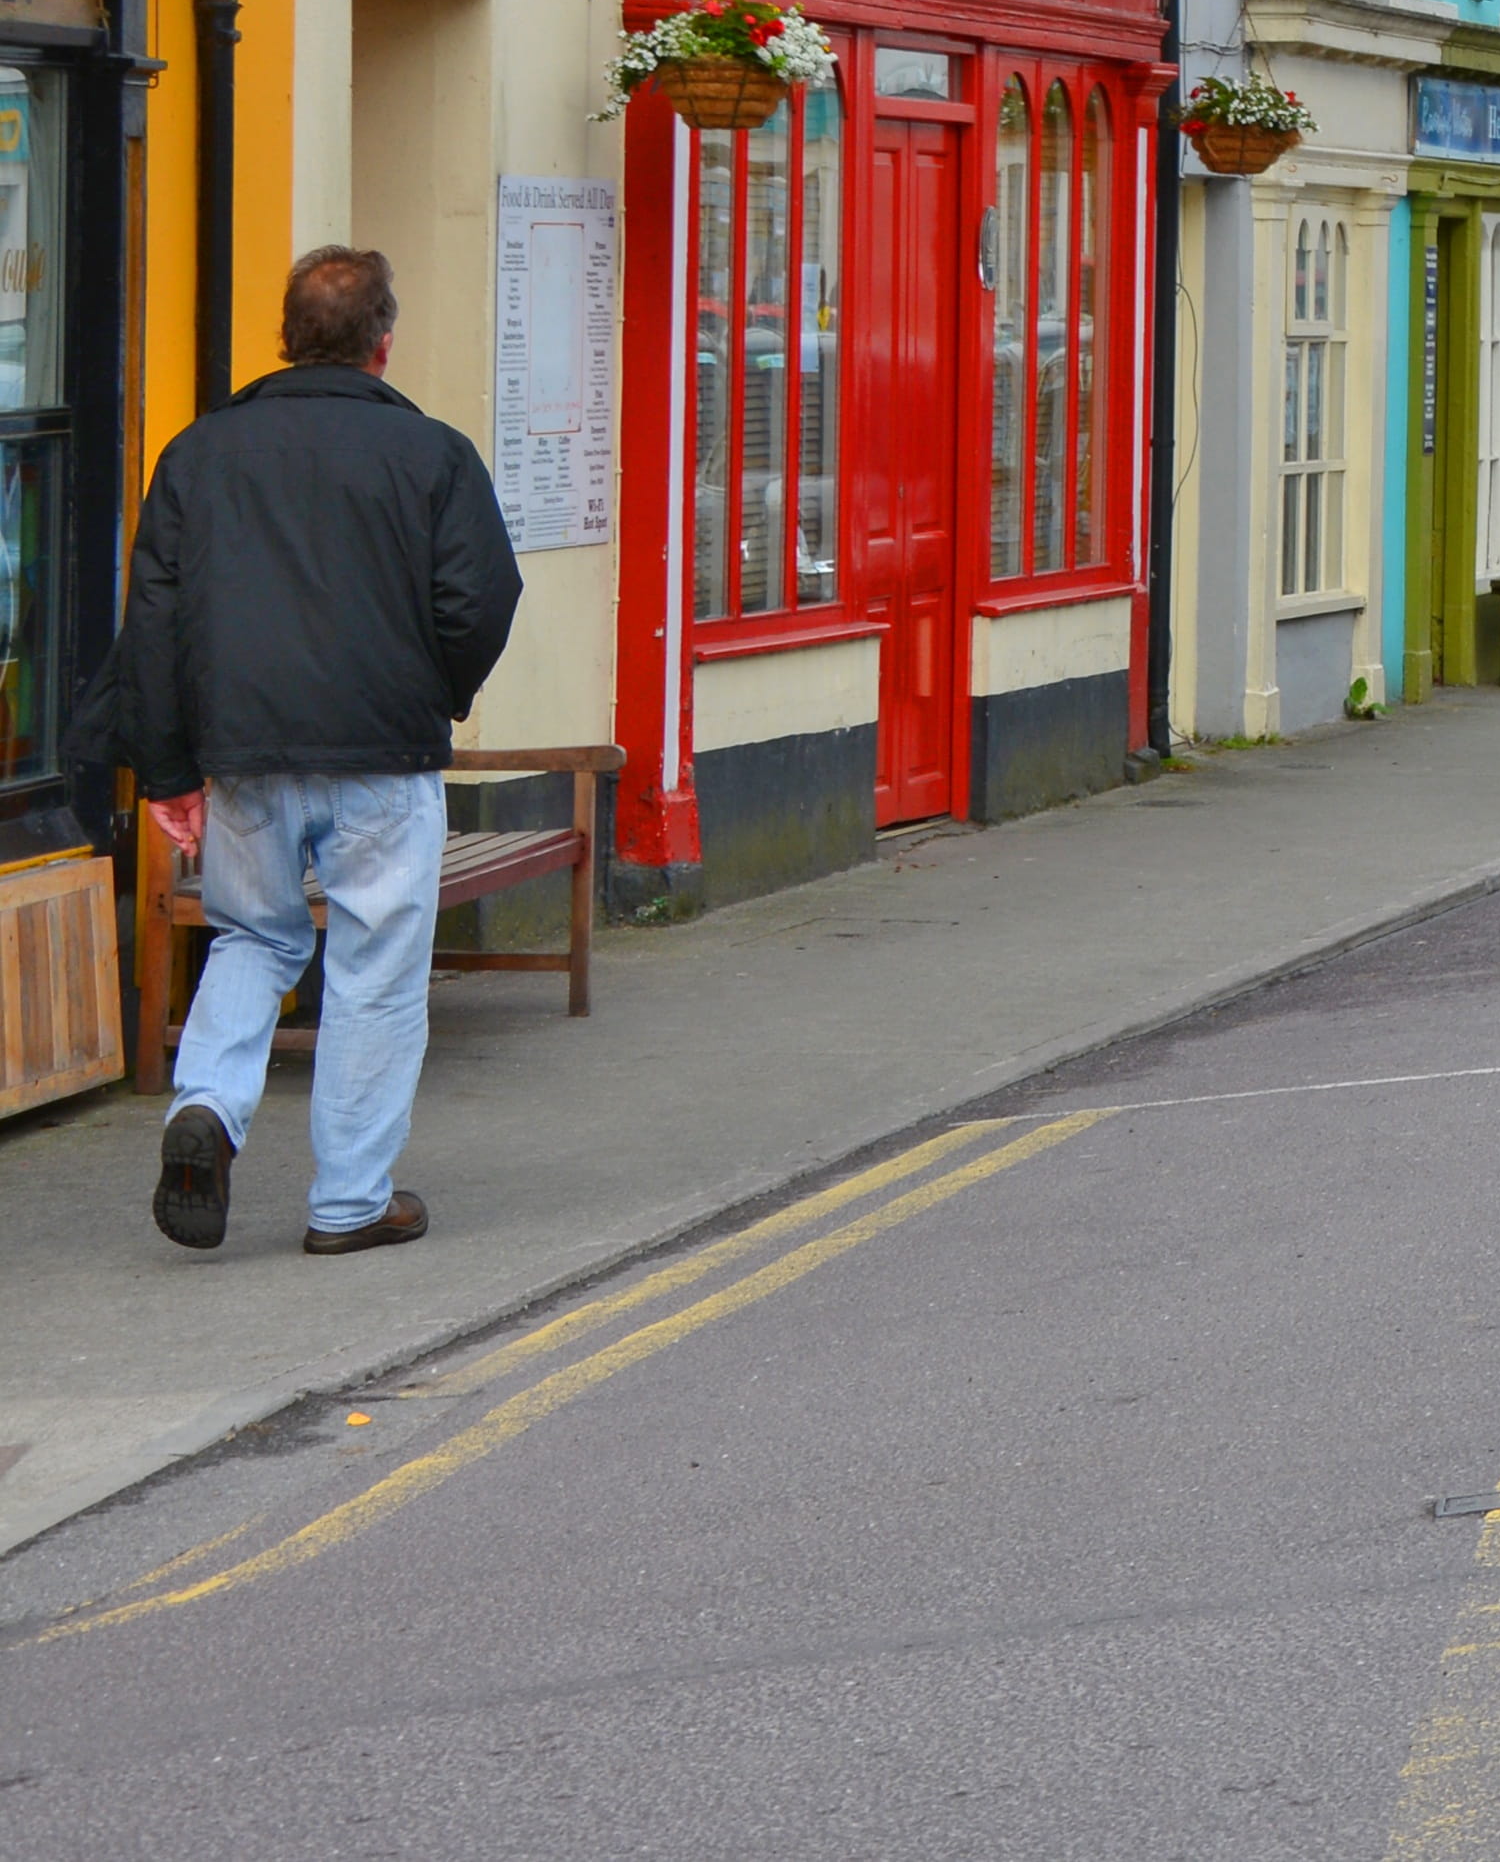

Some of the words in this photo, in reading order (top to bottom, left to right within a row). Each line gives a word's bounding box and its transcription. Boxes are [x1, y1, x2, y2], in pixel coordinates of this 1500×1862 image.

[502, 185, 521, 207] Food
[533, 186, 556, 208] Drink
[558, 186, 584, 209] Served
